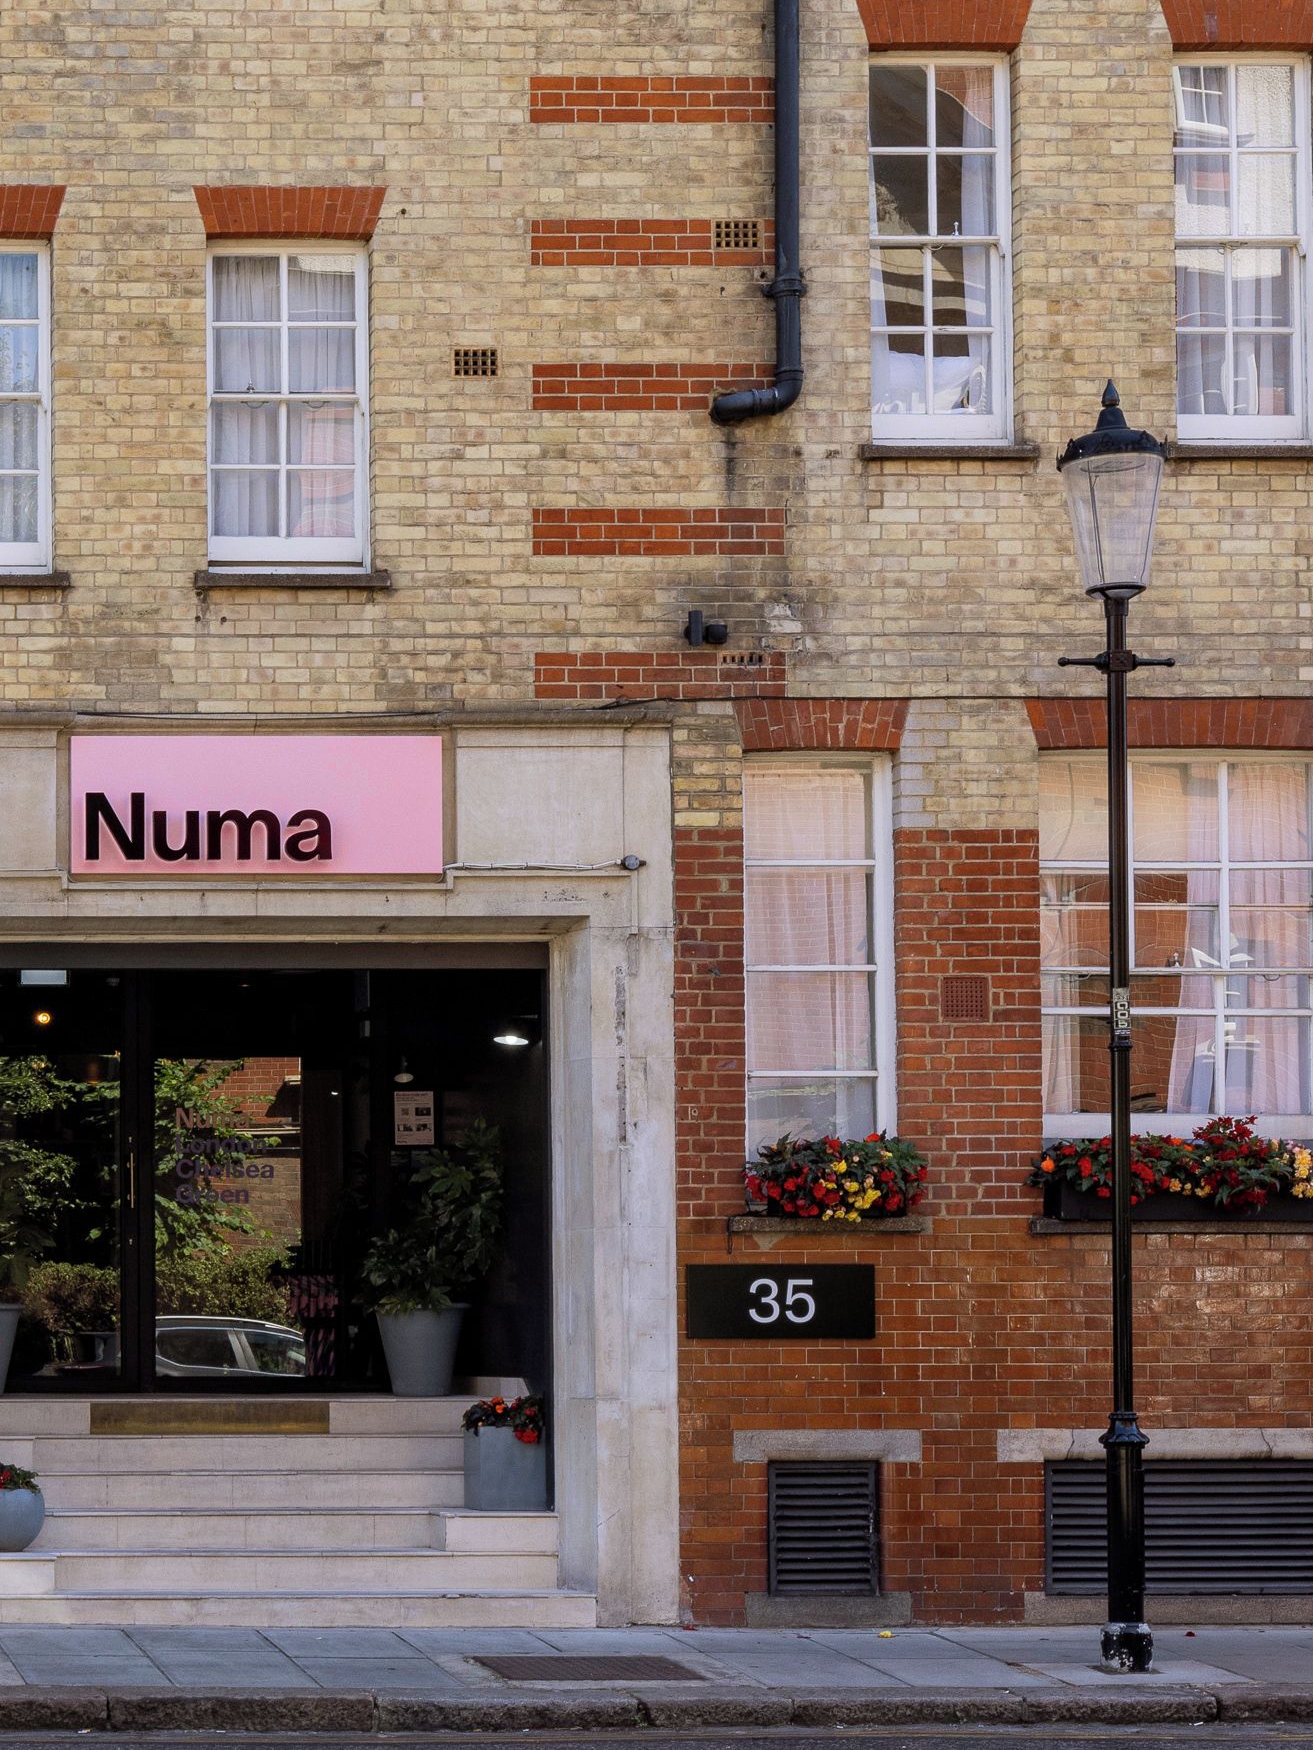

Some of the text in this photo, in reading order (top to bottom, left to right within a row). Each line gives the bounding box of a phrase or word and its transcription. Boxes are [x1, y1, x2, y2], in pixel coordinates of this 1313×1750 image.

[84, 791, 333, 862] Numa
[176, 1107, 250, 1129] Numa
[176, 1133, 267, 1154] London
[176, 1159, 275, 1179] Chelsea
[176, 1183, 250, 1204] Green
[748, 1278, 816, 1323] 35
